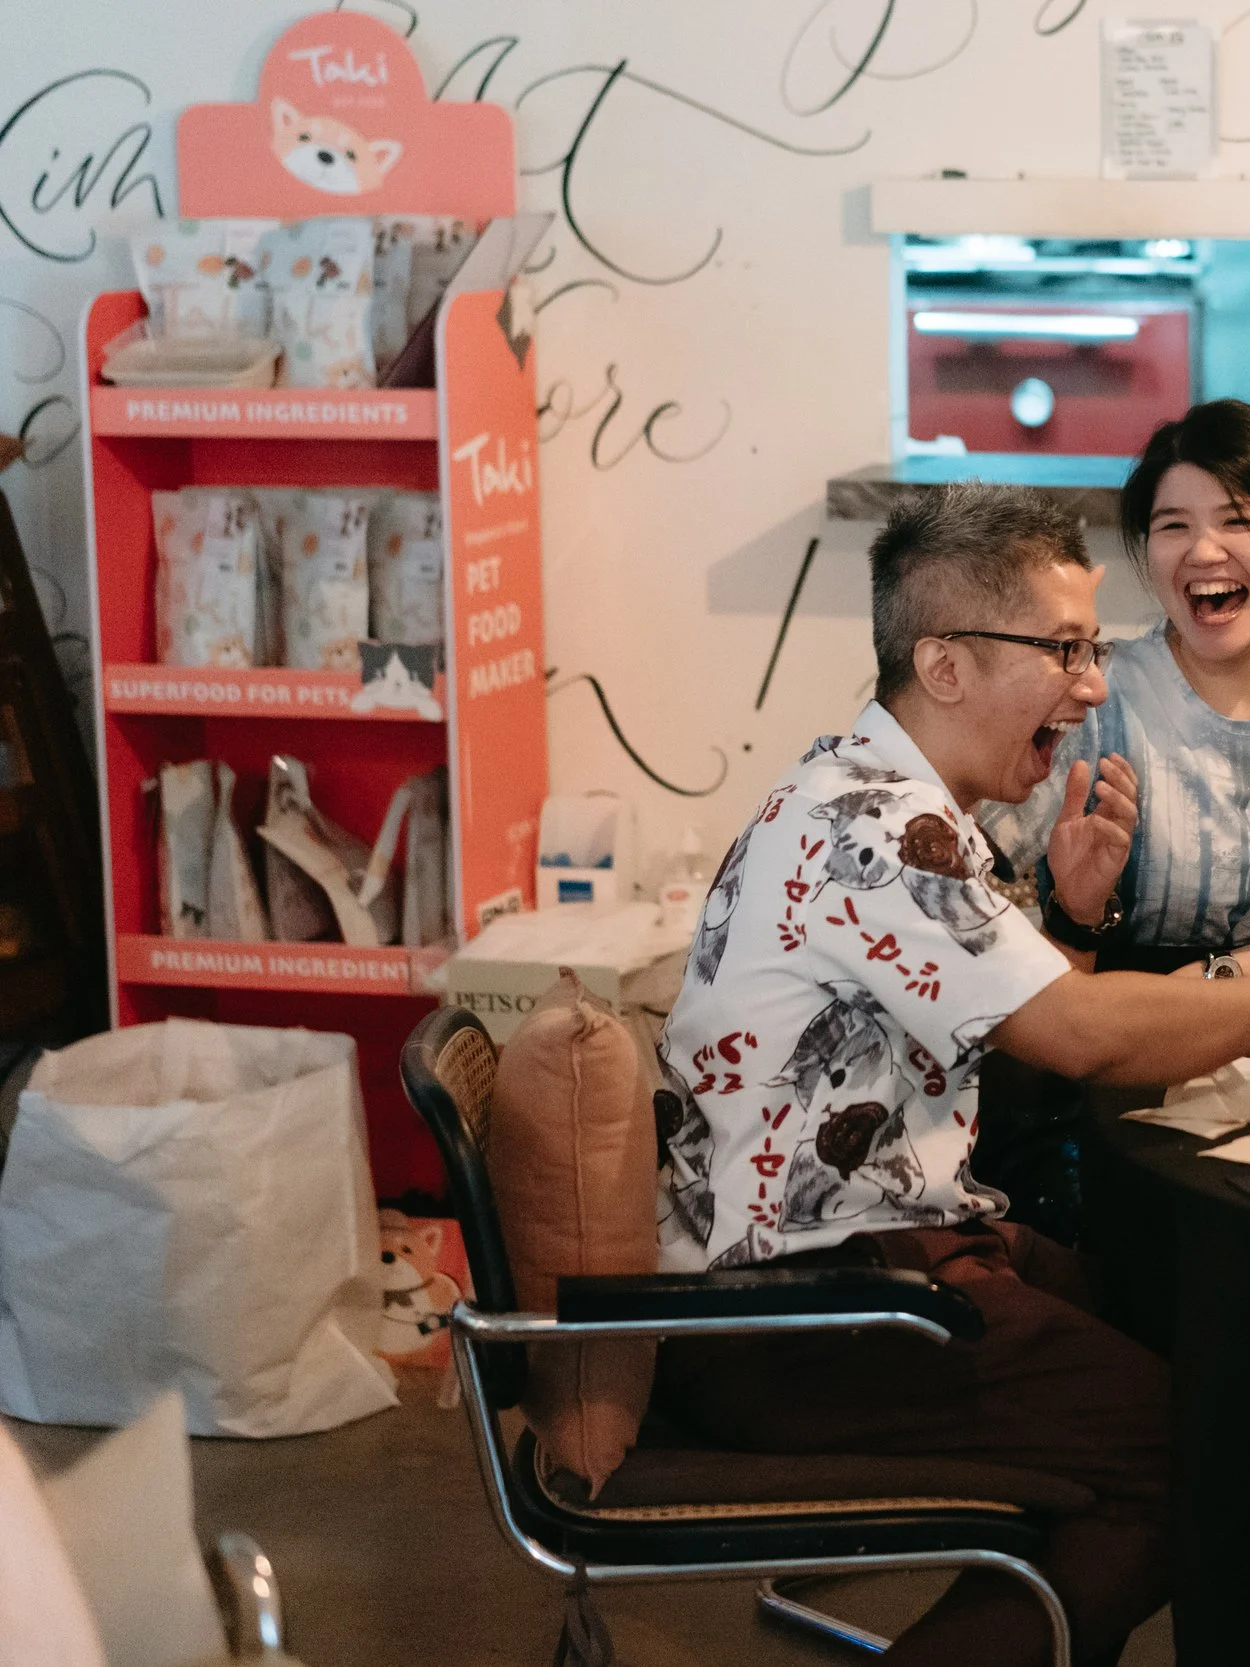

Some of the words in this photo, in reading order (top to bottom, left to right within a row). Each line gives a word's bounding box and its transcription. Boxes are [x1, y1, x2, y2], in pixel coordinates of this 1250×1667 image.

[287, 45, 389, 88] Taki
[127, 401, 241, 424] PREMIUM
[247, 402, 409, 426] INGREDIENTS
[452, 433, 533, 505] Taki
[466, 556, 501, 594] PET
[468, 602, 521, 646] FOOD
[111, 679, 241, 703] SUPERFOOD
[249, 683, 291, 705] FOR
[299, 685, 350, 707] PETS
[470, 648, 535, 699] MAKER
[151, 951, 264, 975] PREMIUM
[269, 957, 410, 981] INGREDIENT
